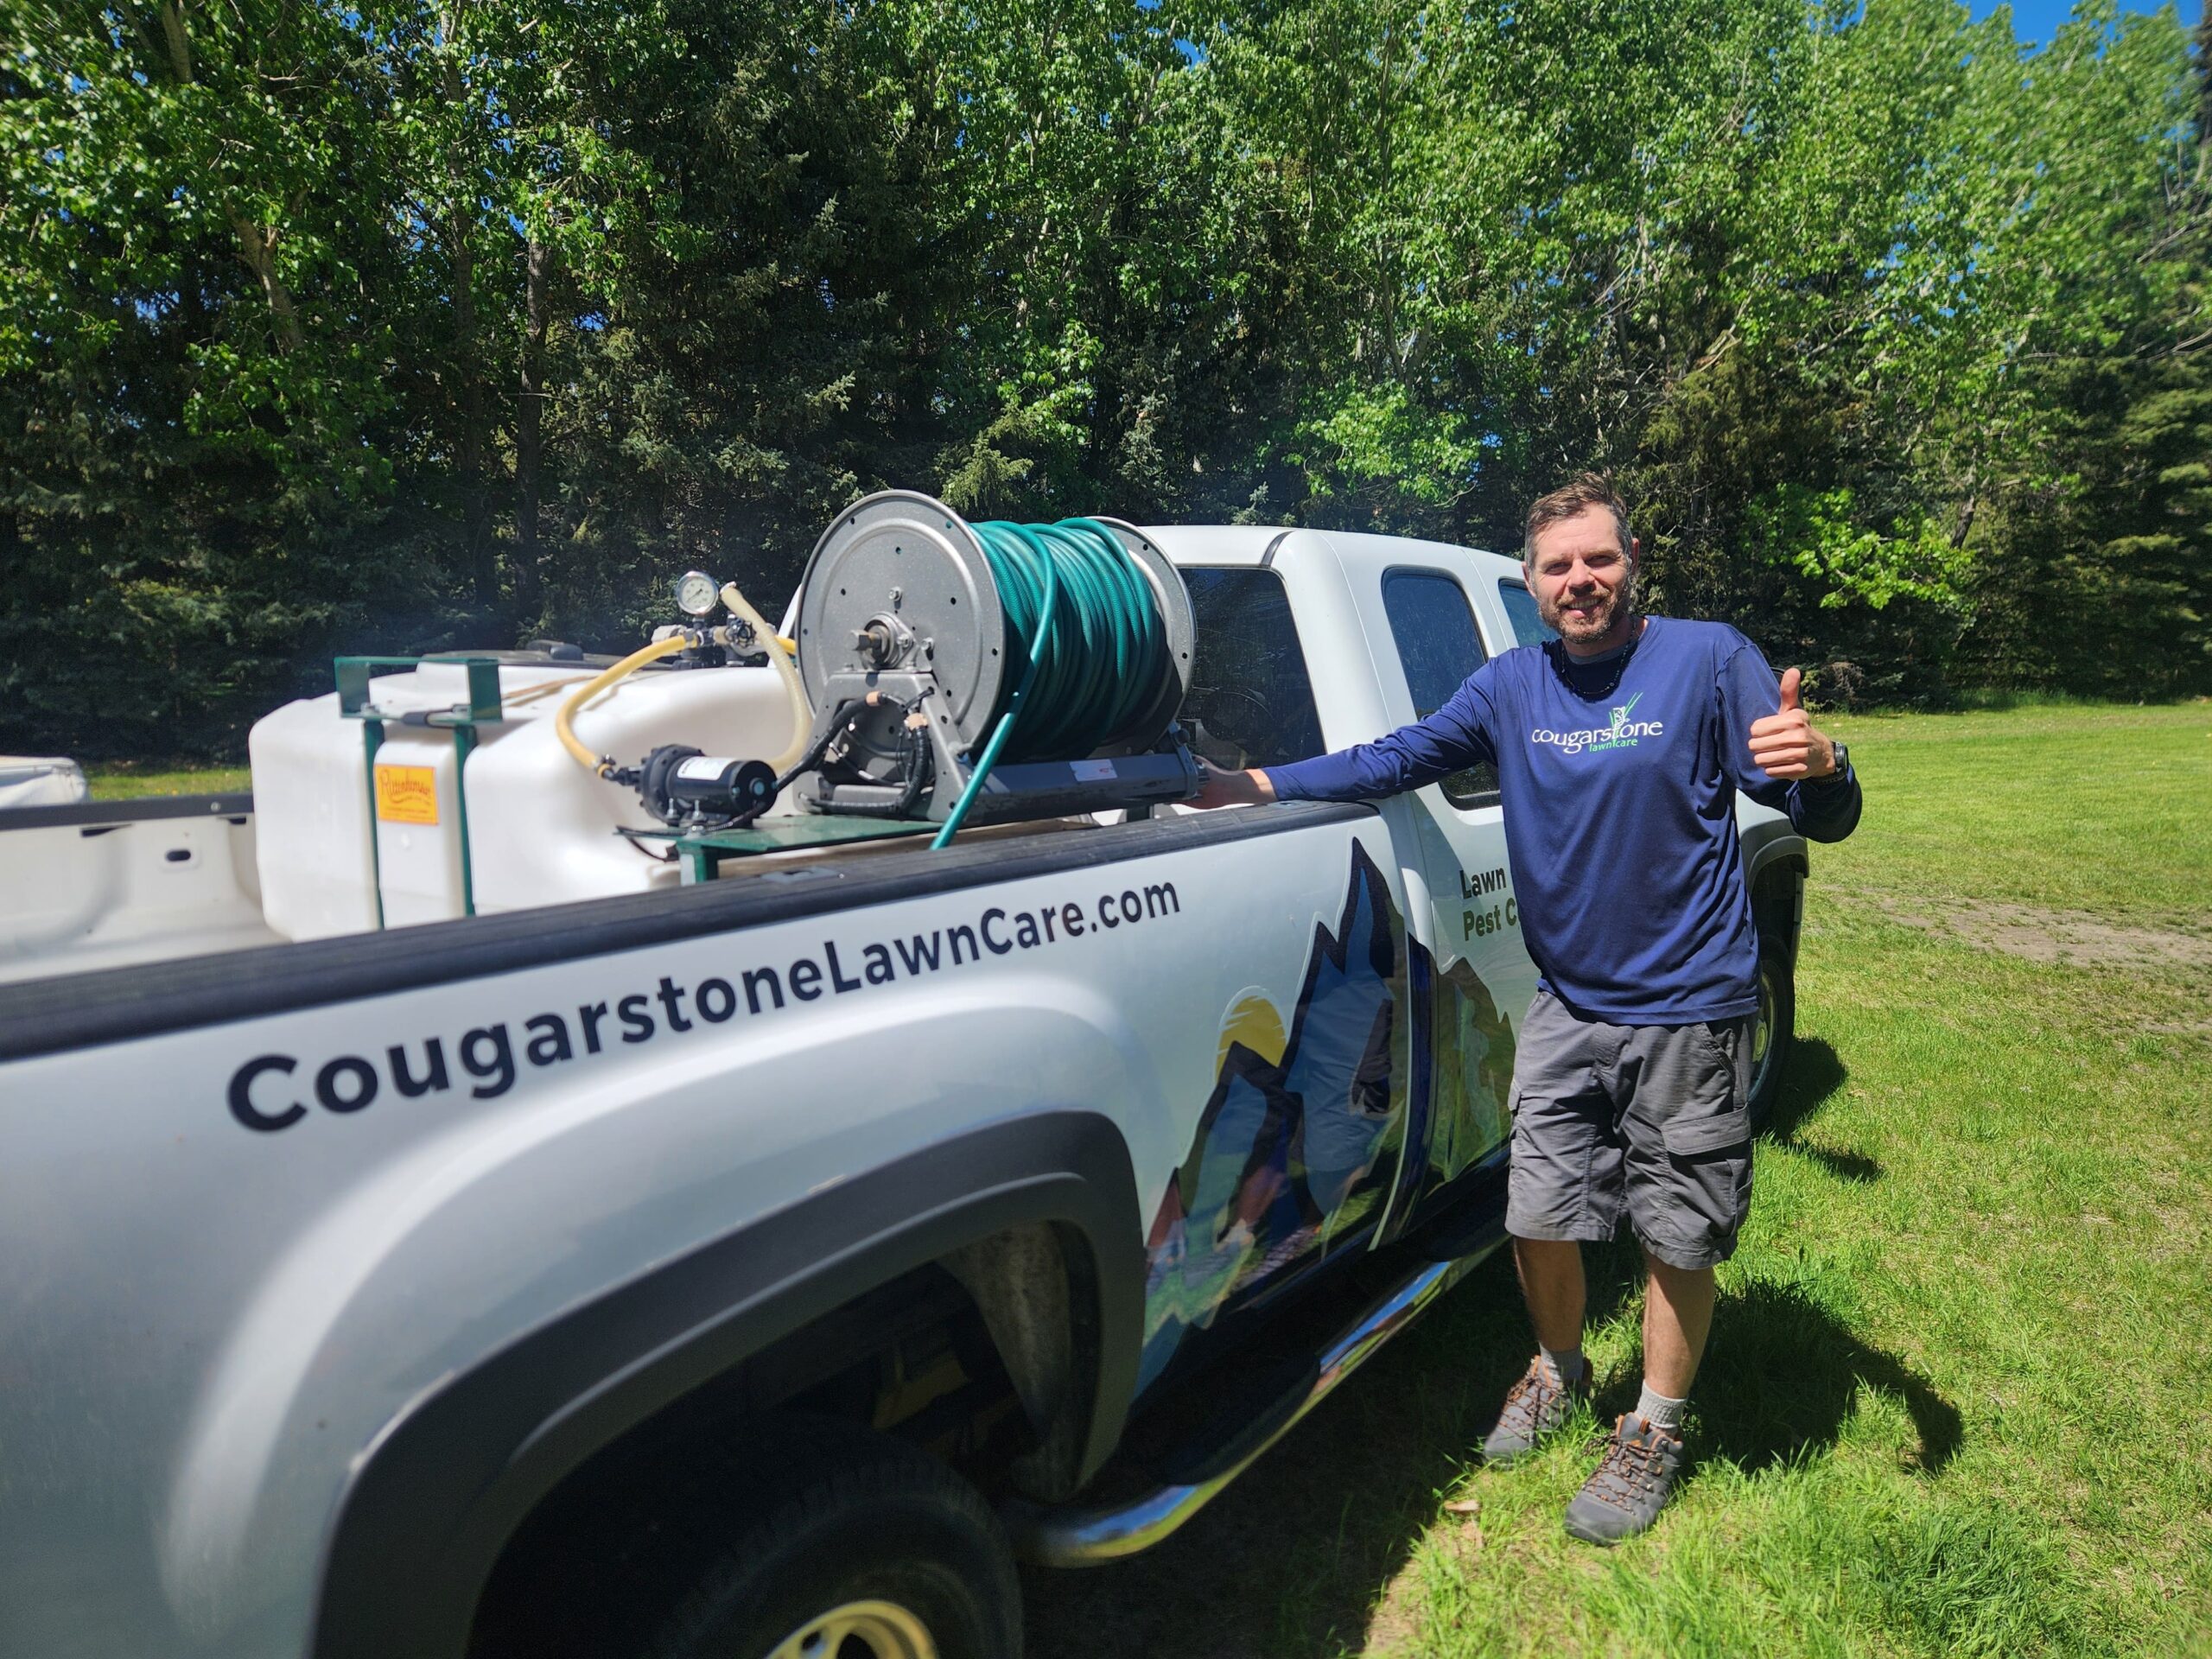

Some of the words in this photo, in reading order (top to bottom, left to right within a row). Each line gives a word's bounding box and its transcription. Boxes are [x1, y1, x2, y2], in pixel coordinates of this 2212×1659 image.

[1531, 720, 1663, 753] cougarstone
[1459, 868, 1507, 899] Lawn
[1463, 906, 1502, 942] Pest
[1505, 897, 1518, 927] C
[227, 882, 1180, 1132] CougarstoneLawnCare.com
